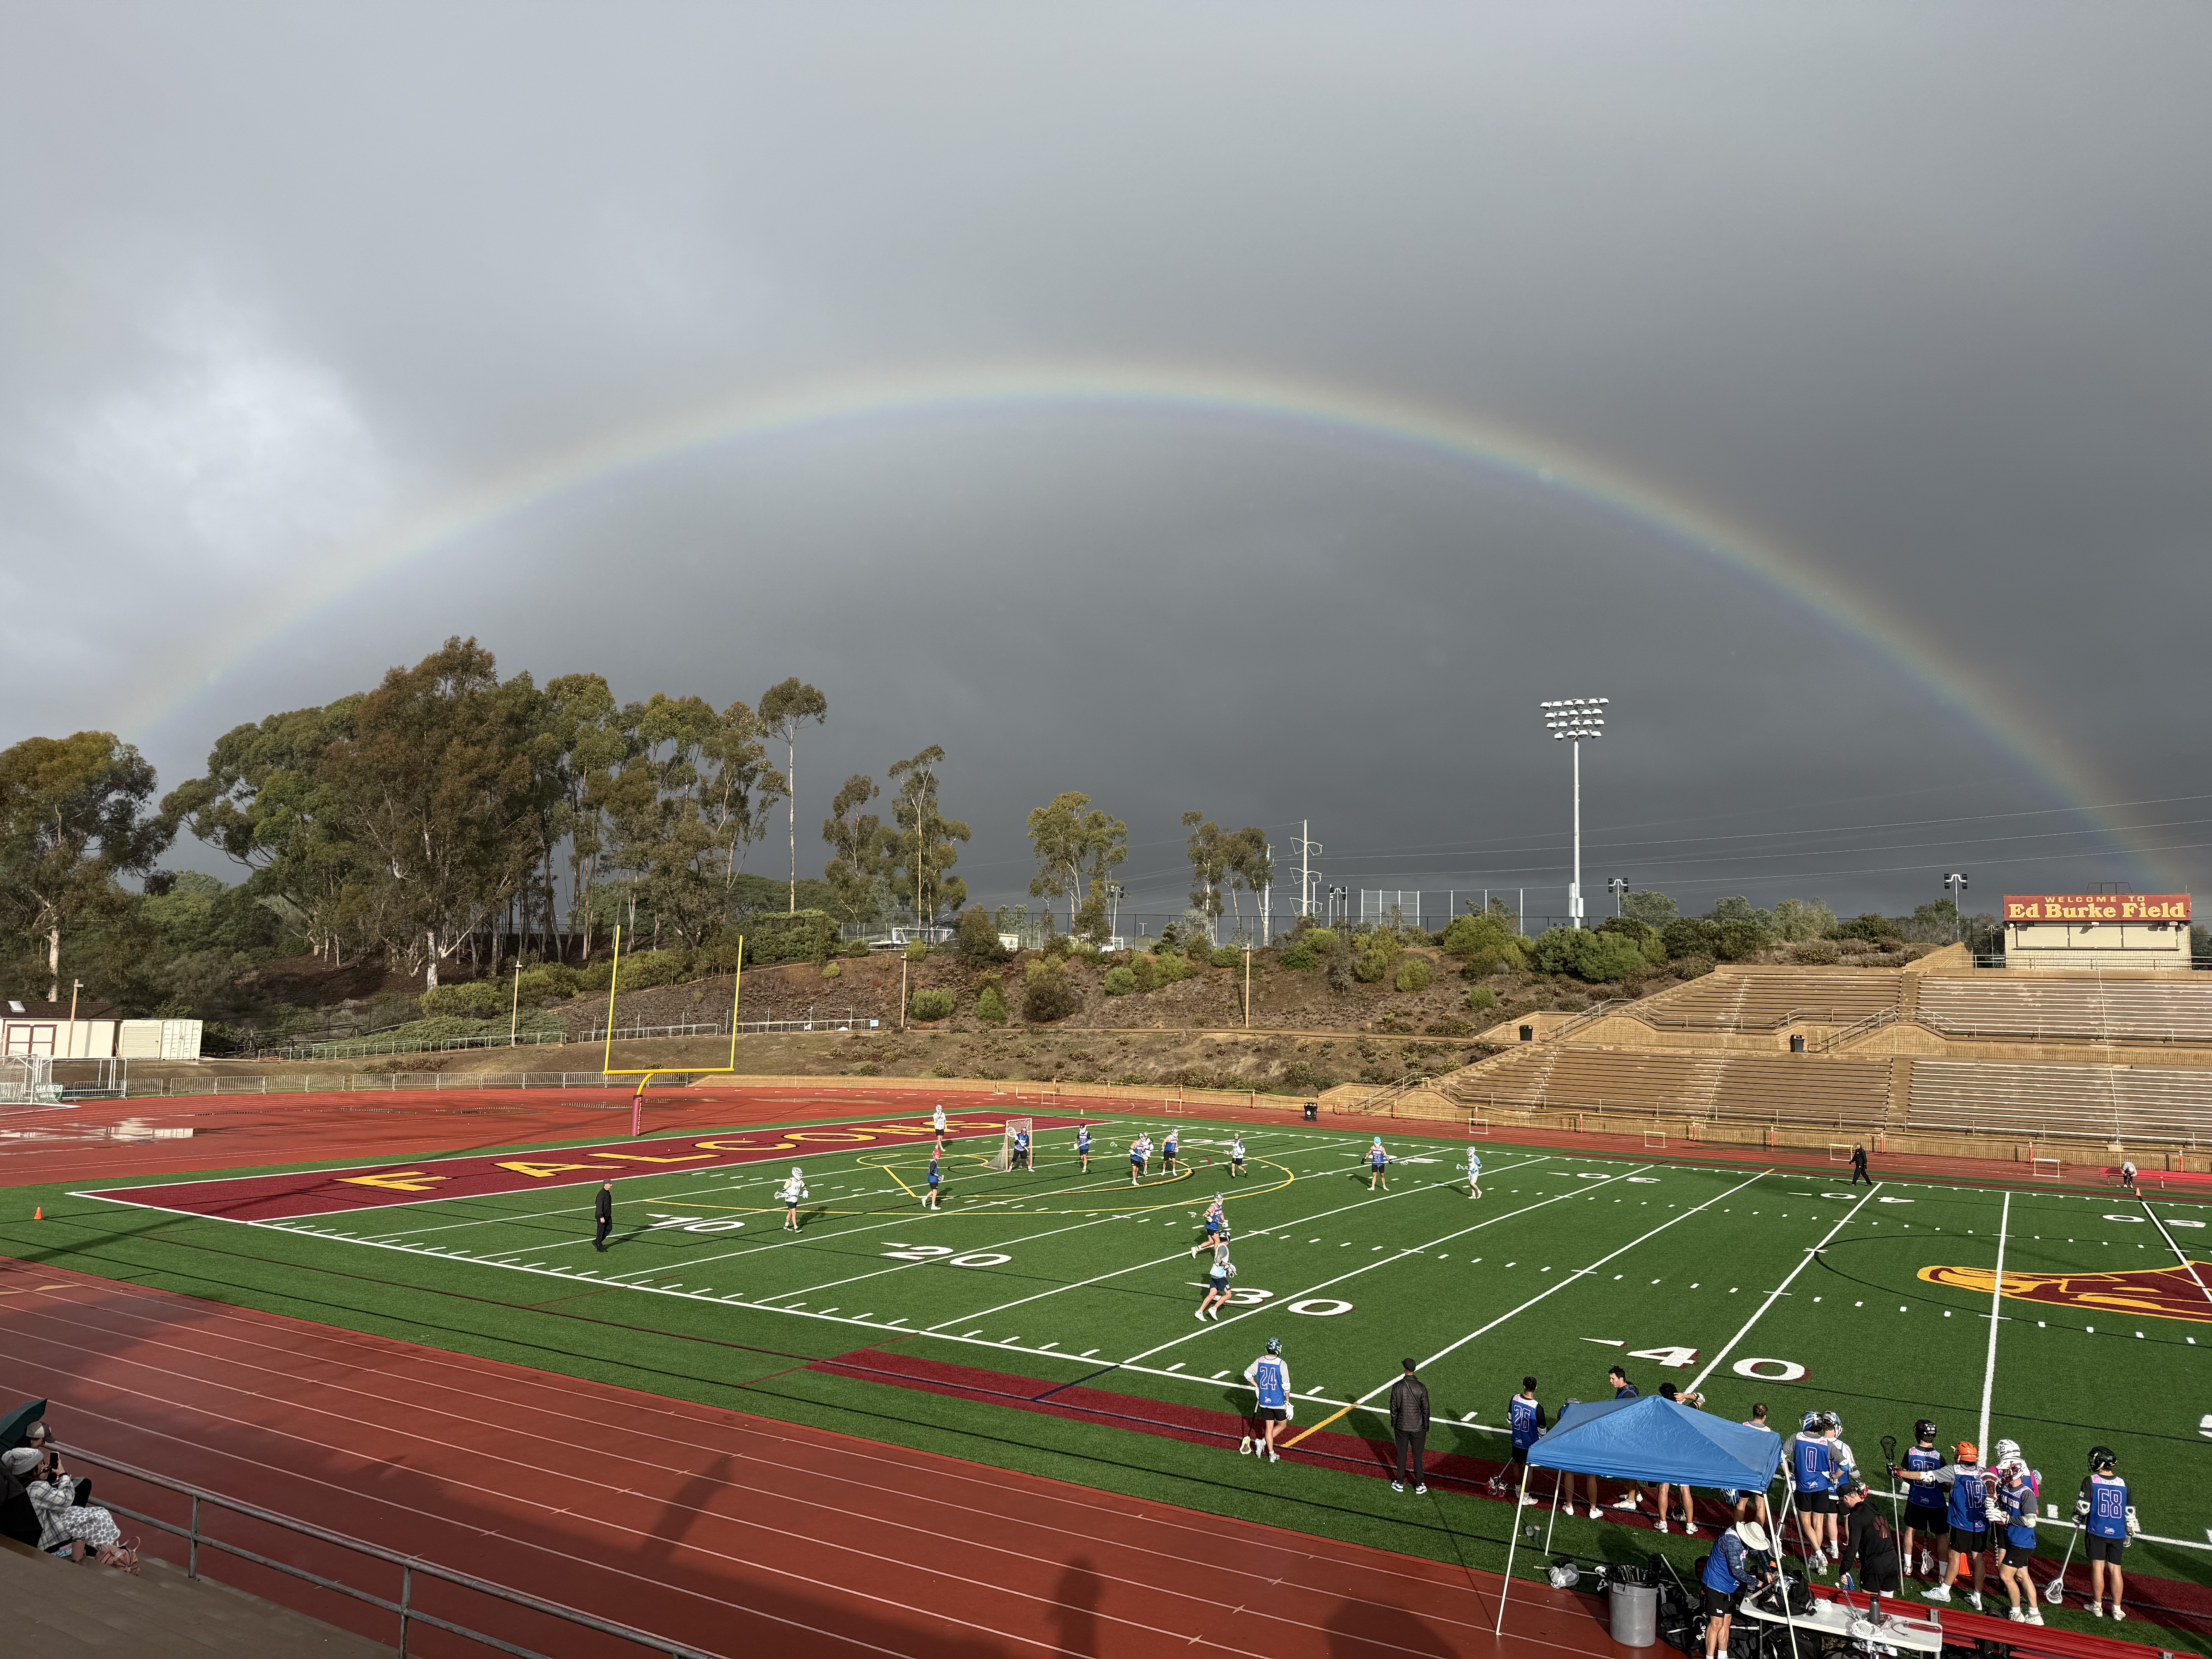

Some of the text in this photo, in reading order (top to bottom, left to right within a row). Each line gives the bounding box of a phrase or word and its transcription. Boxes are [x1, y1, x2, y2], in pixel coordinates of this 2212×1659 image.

[2009, 902, 2186, 918] Ed Burke Field
[35, 1085, 63, 1093] SAN DIEGO
[648, 1216, 745, 1232] 10
[879, 1245, 1013, 1267] 20
[1213, 1288, 1353, 1316] 30
[1626, 1346, 1805, 1381] 40
[1260, 1366, 1277, 1390] 24
[1513, 1405, 1531, 1432] 26
[1806, 1446, 1817, 1472] 0
[1966, 1480, 1982, 1508] 19
[2098, 1488, 2122, 1519] 68
